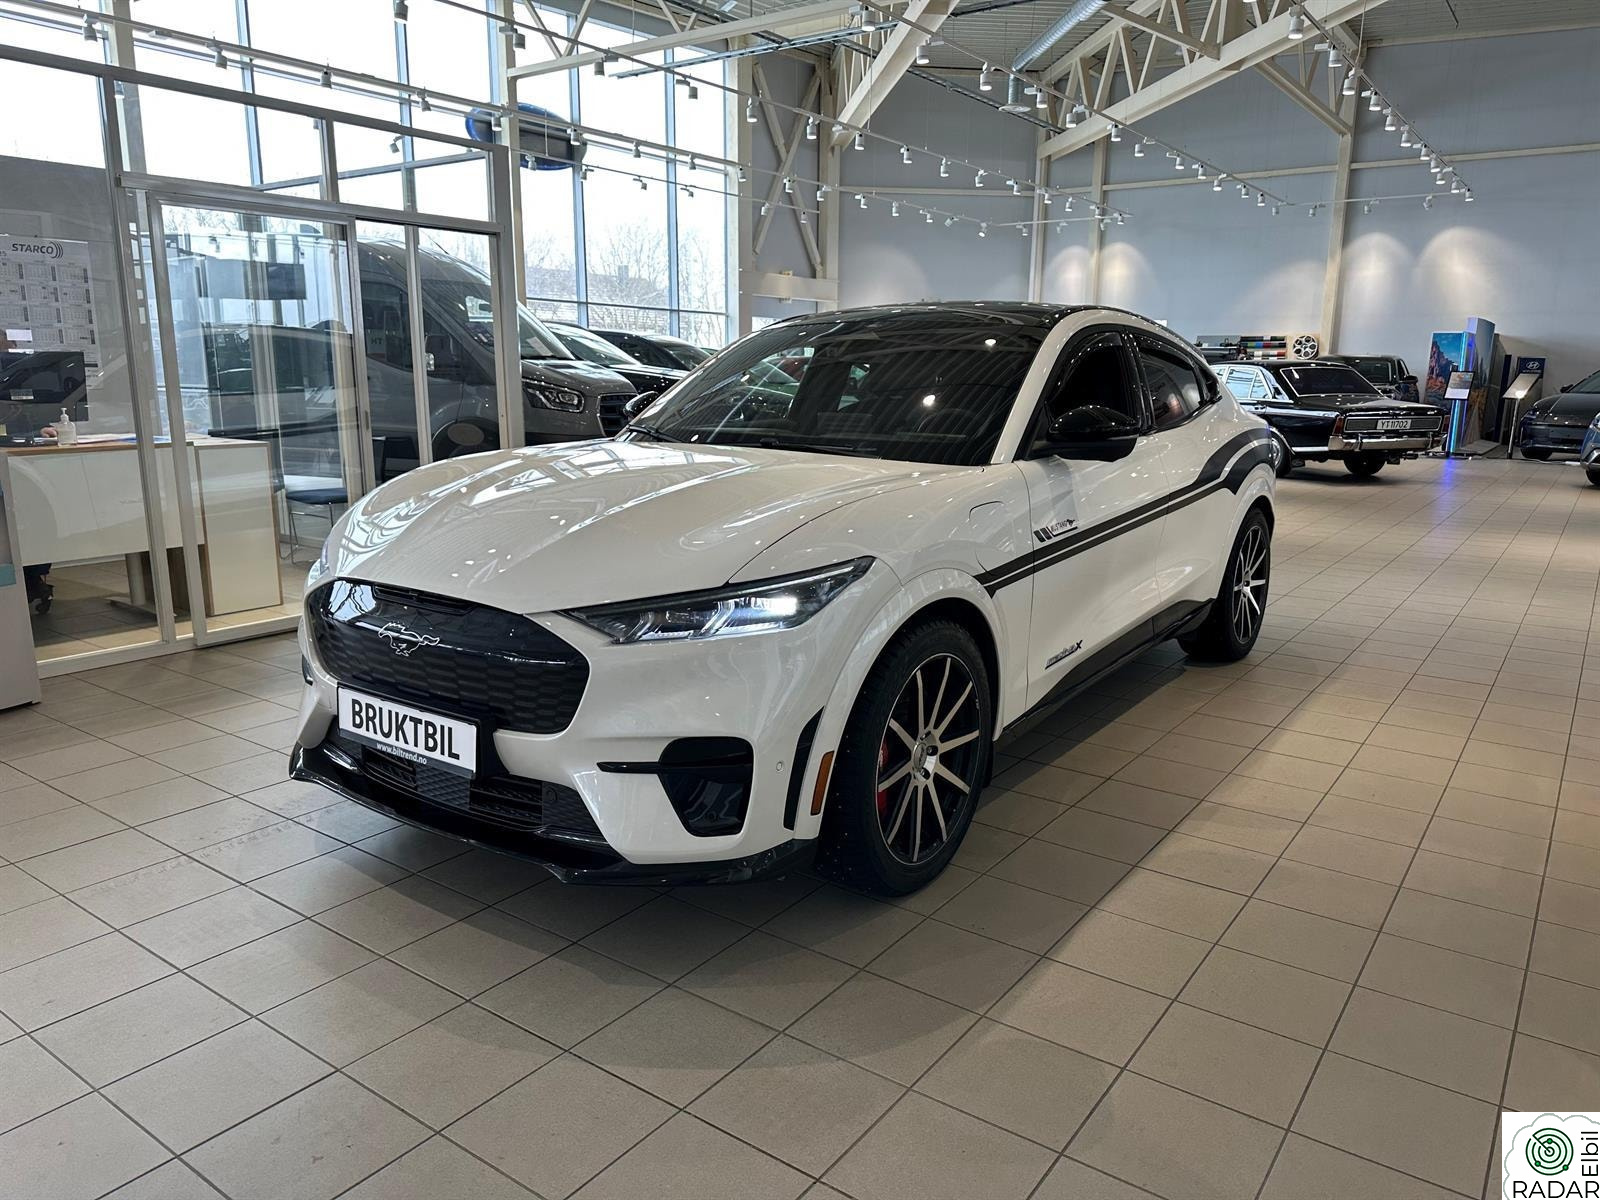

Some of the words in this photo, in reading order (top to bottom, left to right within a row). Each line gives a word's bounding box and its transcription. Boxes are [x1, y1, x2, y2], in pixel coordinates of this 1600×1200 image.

[11, 243, 54, 255] STARCO
[1381, 420, 1390, 429] YT
[1390, 420, 1409, 429] 11702
[351, 698, 460, 761] BRUKTBIL
[376, 742, 428, 765] www.biltrend.no
